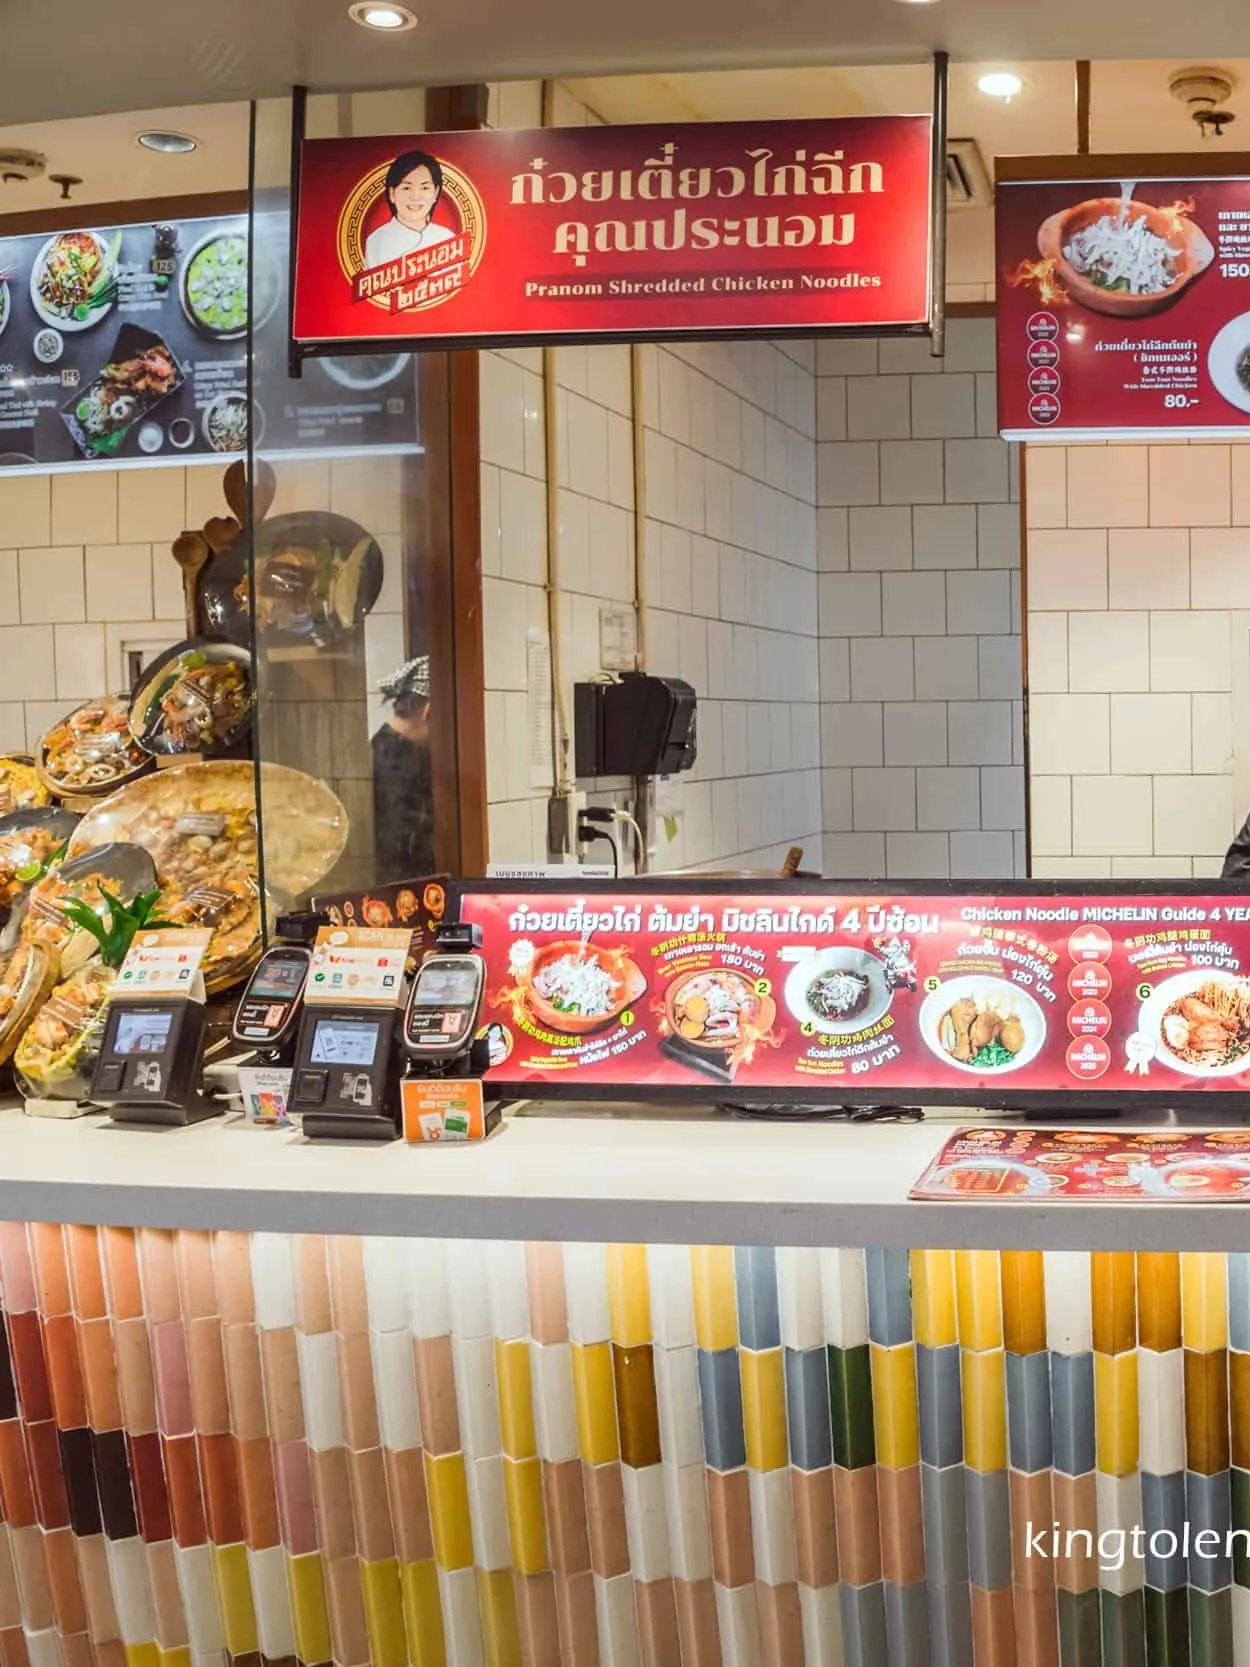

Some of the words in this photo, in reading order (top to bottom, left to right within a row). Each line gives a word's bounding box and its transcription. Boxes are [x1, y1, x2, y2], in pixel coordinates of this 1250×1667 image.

[509, 141, 885, 205] ก๋วยเตี๋ยวไก่ฉีก
[552, 209, 857, 267] คุณประนอม
[525, 281, 602, 298] Pranom
[608, 278, 705, 296] Shredded
[711, 275, 795, 293] Chicken
[799, 272, 882, 290] Noodles
[1164, 394, 1199, 408] 80.-
[647, 904, 714, 932] ต้มยำ
[840, 908, 860, 931] 4
[961, 908, 1021, 921] Chicken
[1025, 908, 1079, 921] Noodle
[1082, 908, 1157, 921] MICHELIN
[1161, 908, 1205, 922] Guide
[1210, 908, 1221, 921] 4
[1191, 954, 1213, 966] 100
[1011, 969, 1033, 985] 120
[758, 982, 767, 993] 2
[928, 979, 937, 990] 5
[1139, 984, 1151, 999] 6
[804, 1022, 812, 1033] 4
